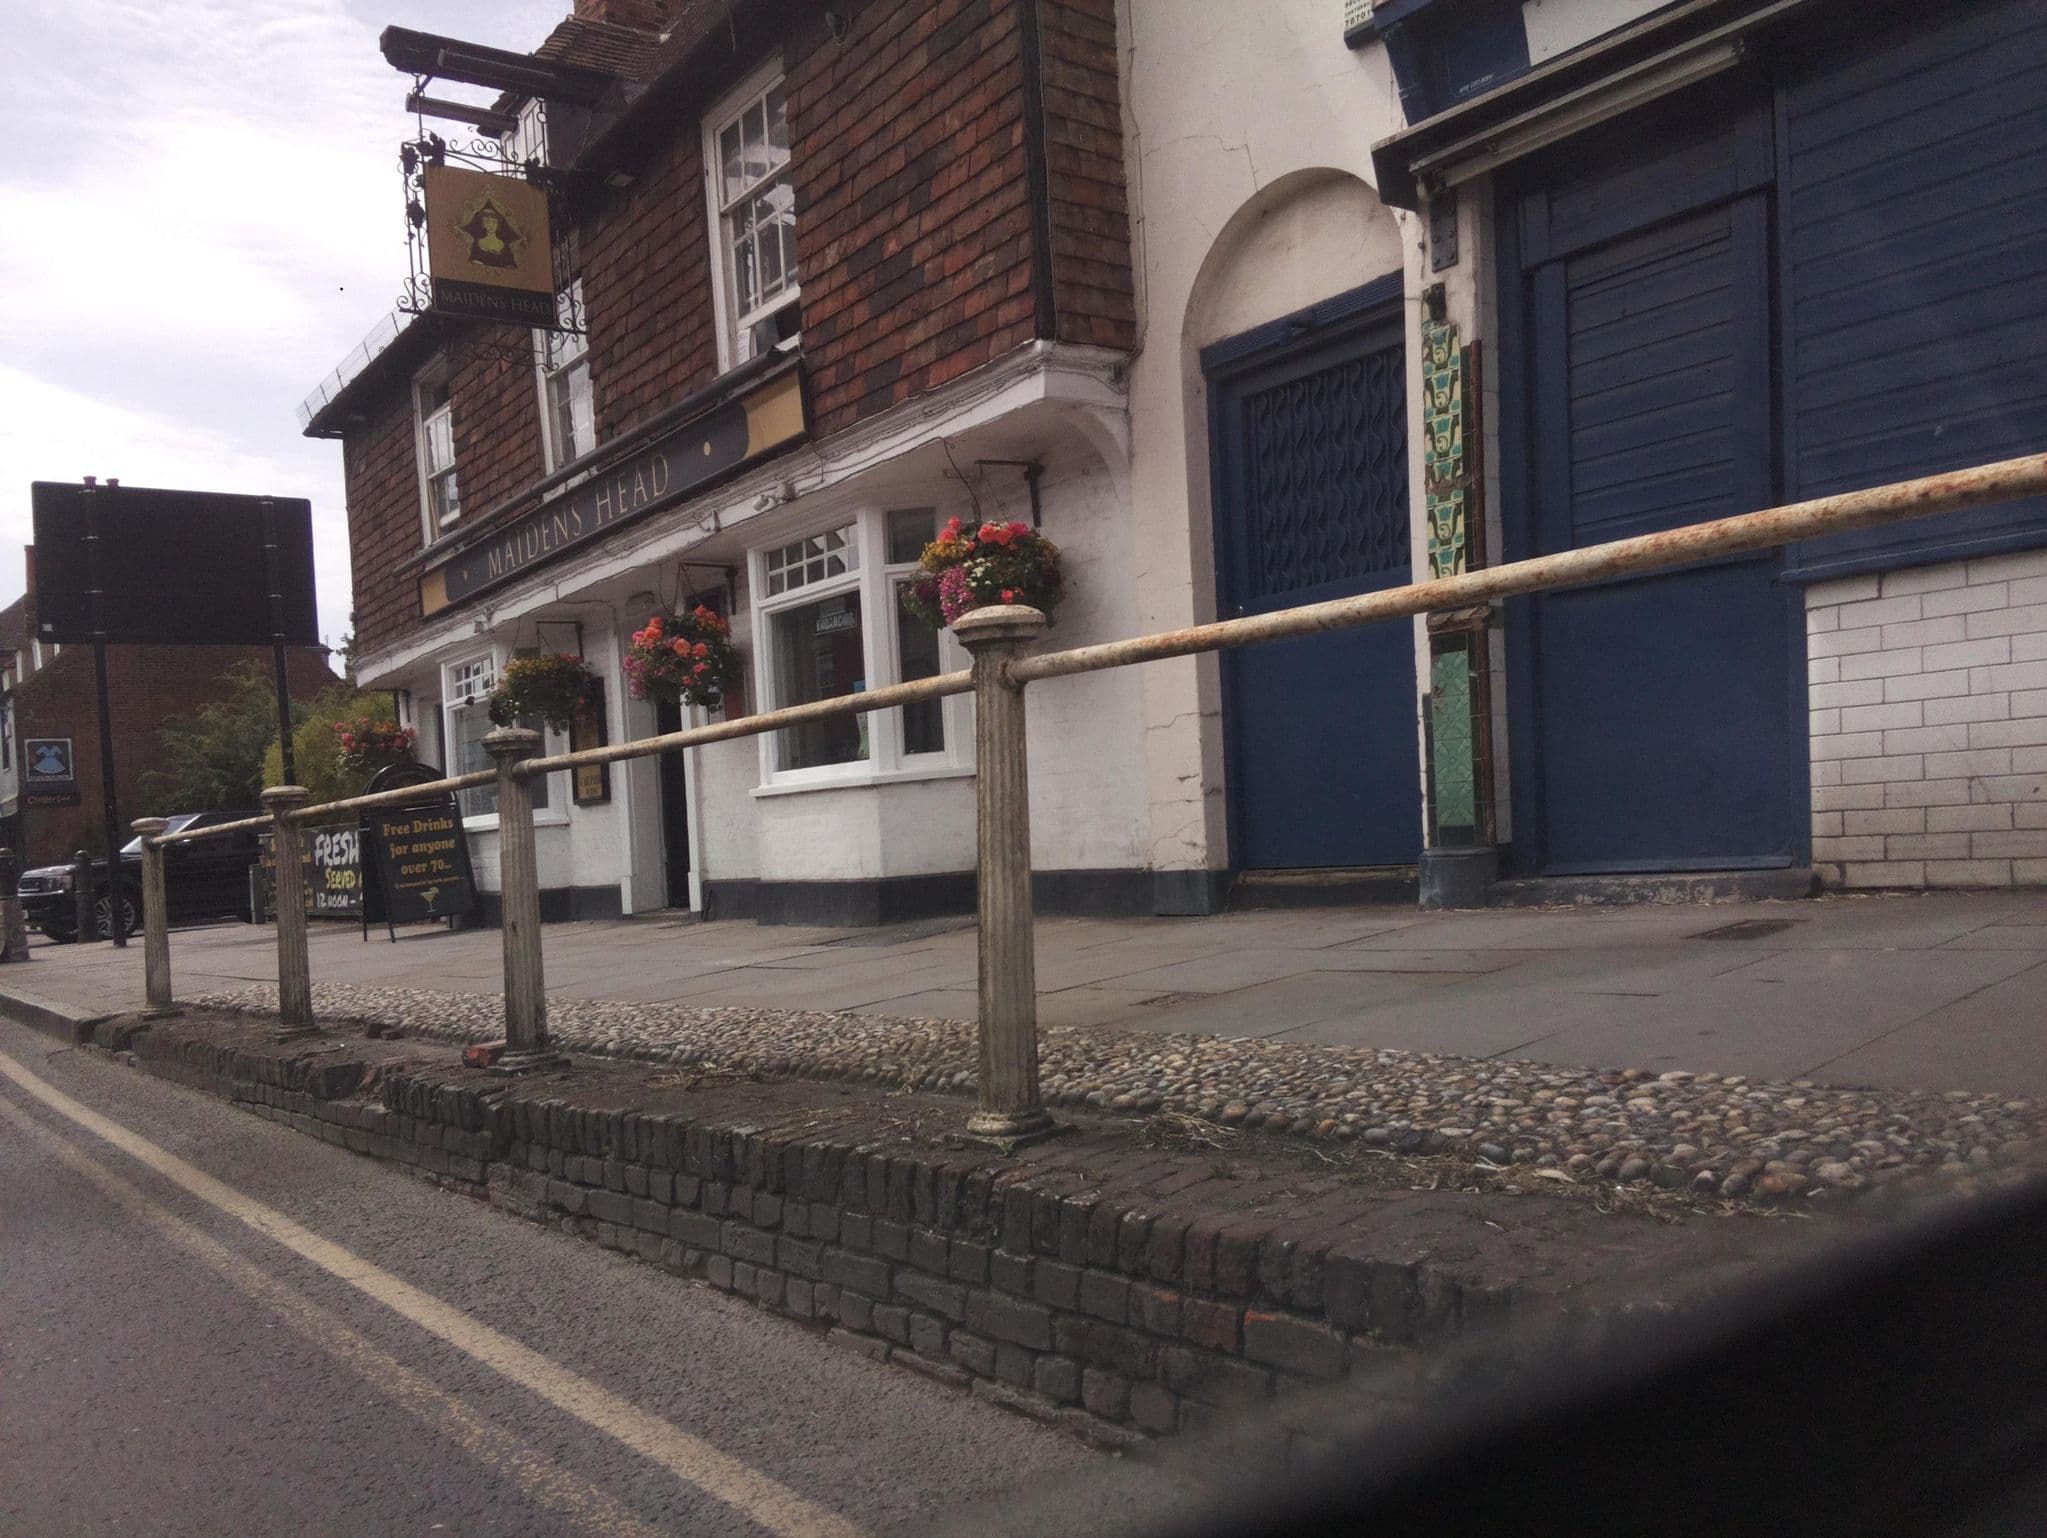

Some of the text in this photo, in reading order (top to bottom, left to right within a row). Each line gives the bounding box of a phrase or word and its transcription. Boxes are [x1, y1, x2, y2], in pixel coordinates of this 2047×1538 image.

[440, 287, 551, 314] MAIDENS HEAD
[487, 454, 669, 578] MAIDENS HEAD
[382, 817, 454, 837] Free Drinks
[314, 830, 360, 867] FRESH
[389, 838, 456, 859] for anyone
[325, 867, 356, 889] SERVED
[401, 863, 428, 875] over
[316, 892, 327, 908] 12
[327, 894, 348, 908] NOON
